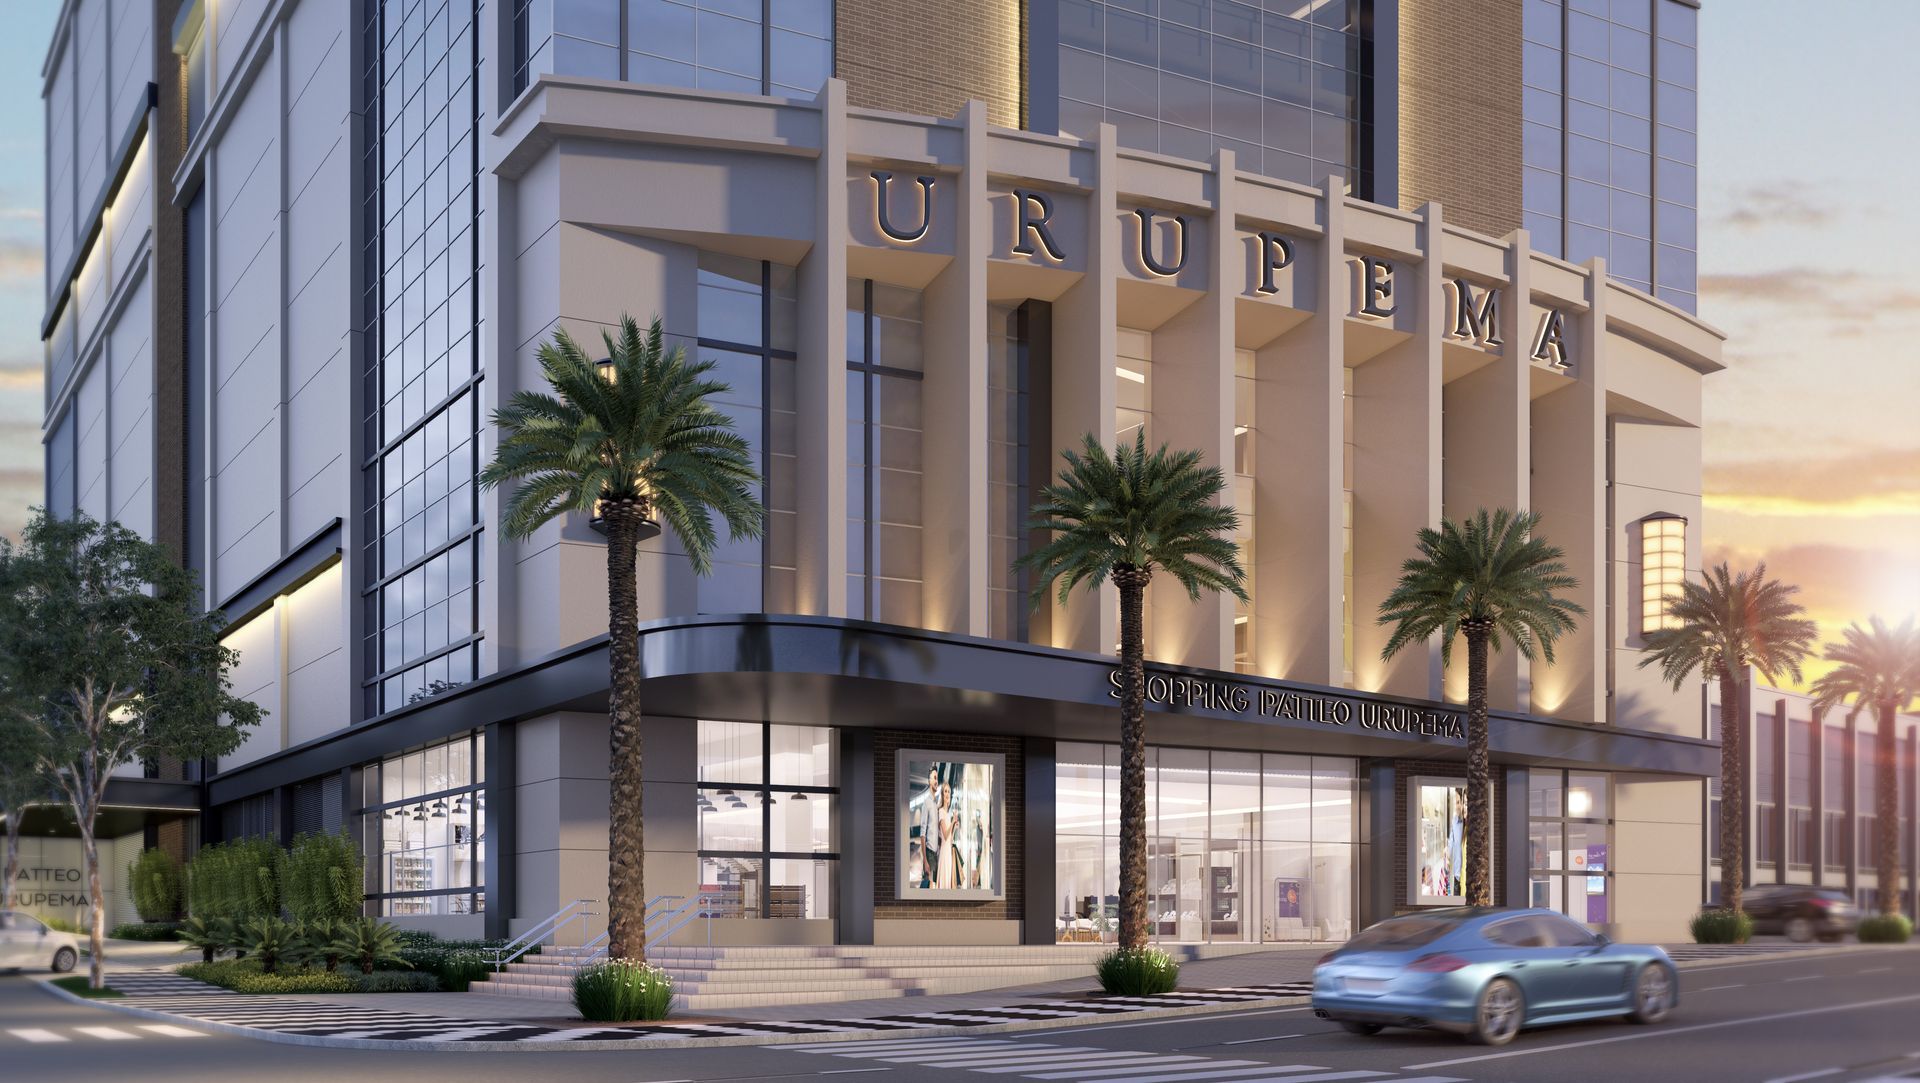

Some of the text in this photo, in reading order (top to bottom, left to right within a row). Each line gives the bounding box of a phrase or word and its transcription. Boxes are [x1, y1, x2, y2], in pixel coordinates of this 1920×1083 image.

[1109, 670, 1464, 739] SOPPING PATTEO URUPEMA
[0, 893, 89, 907] UPEMA
